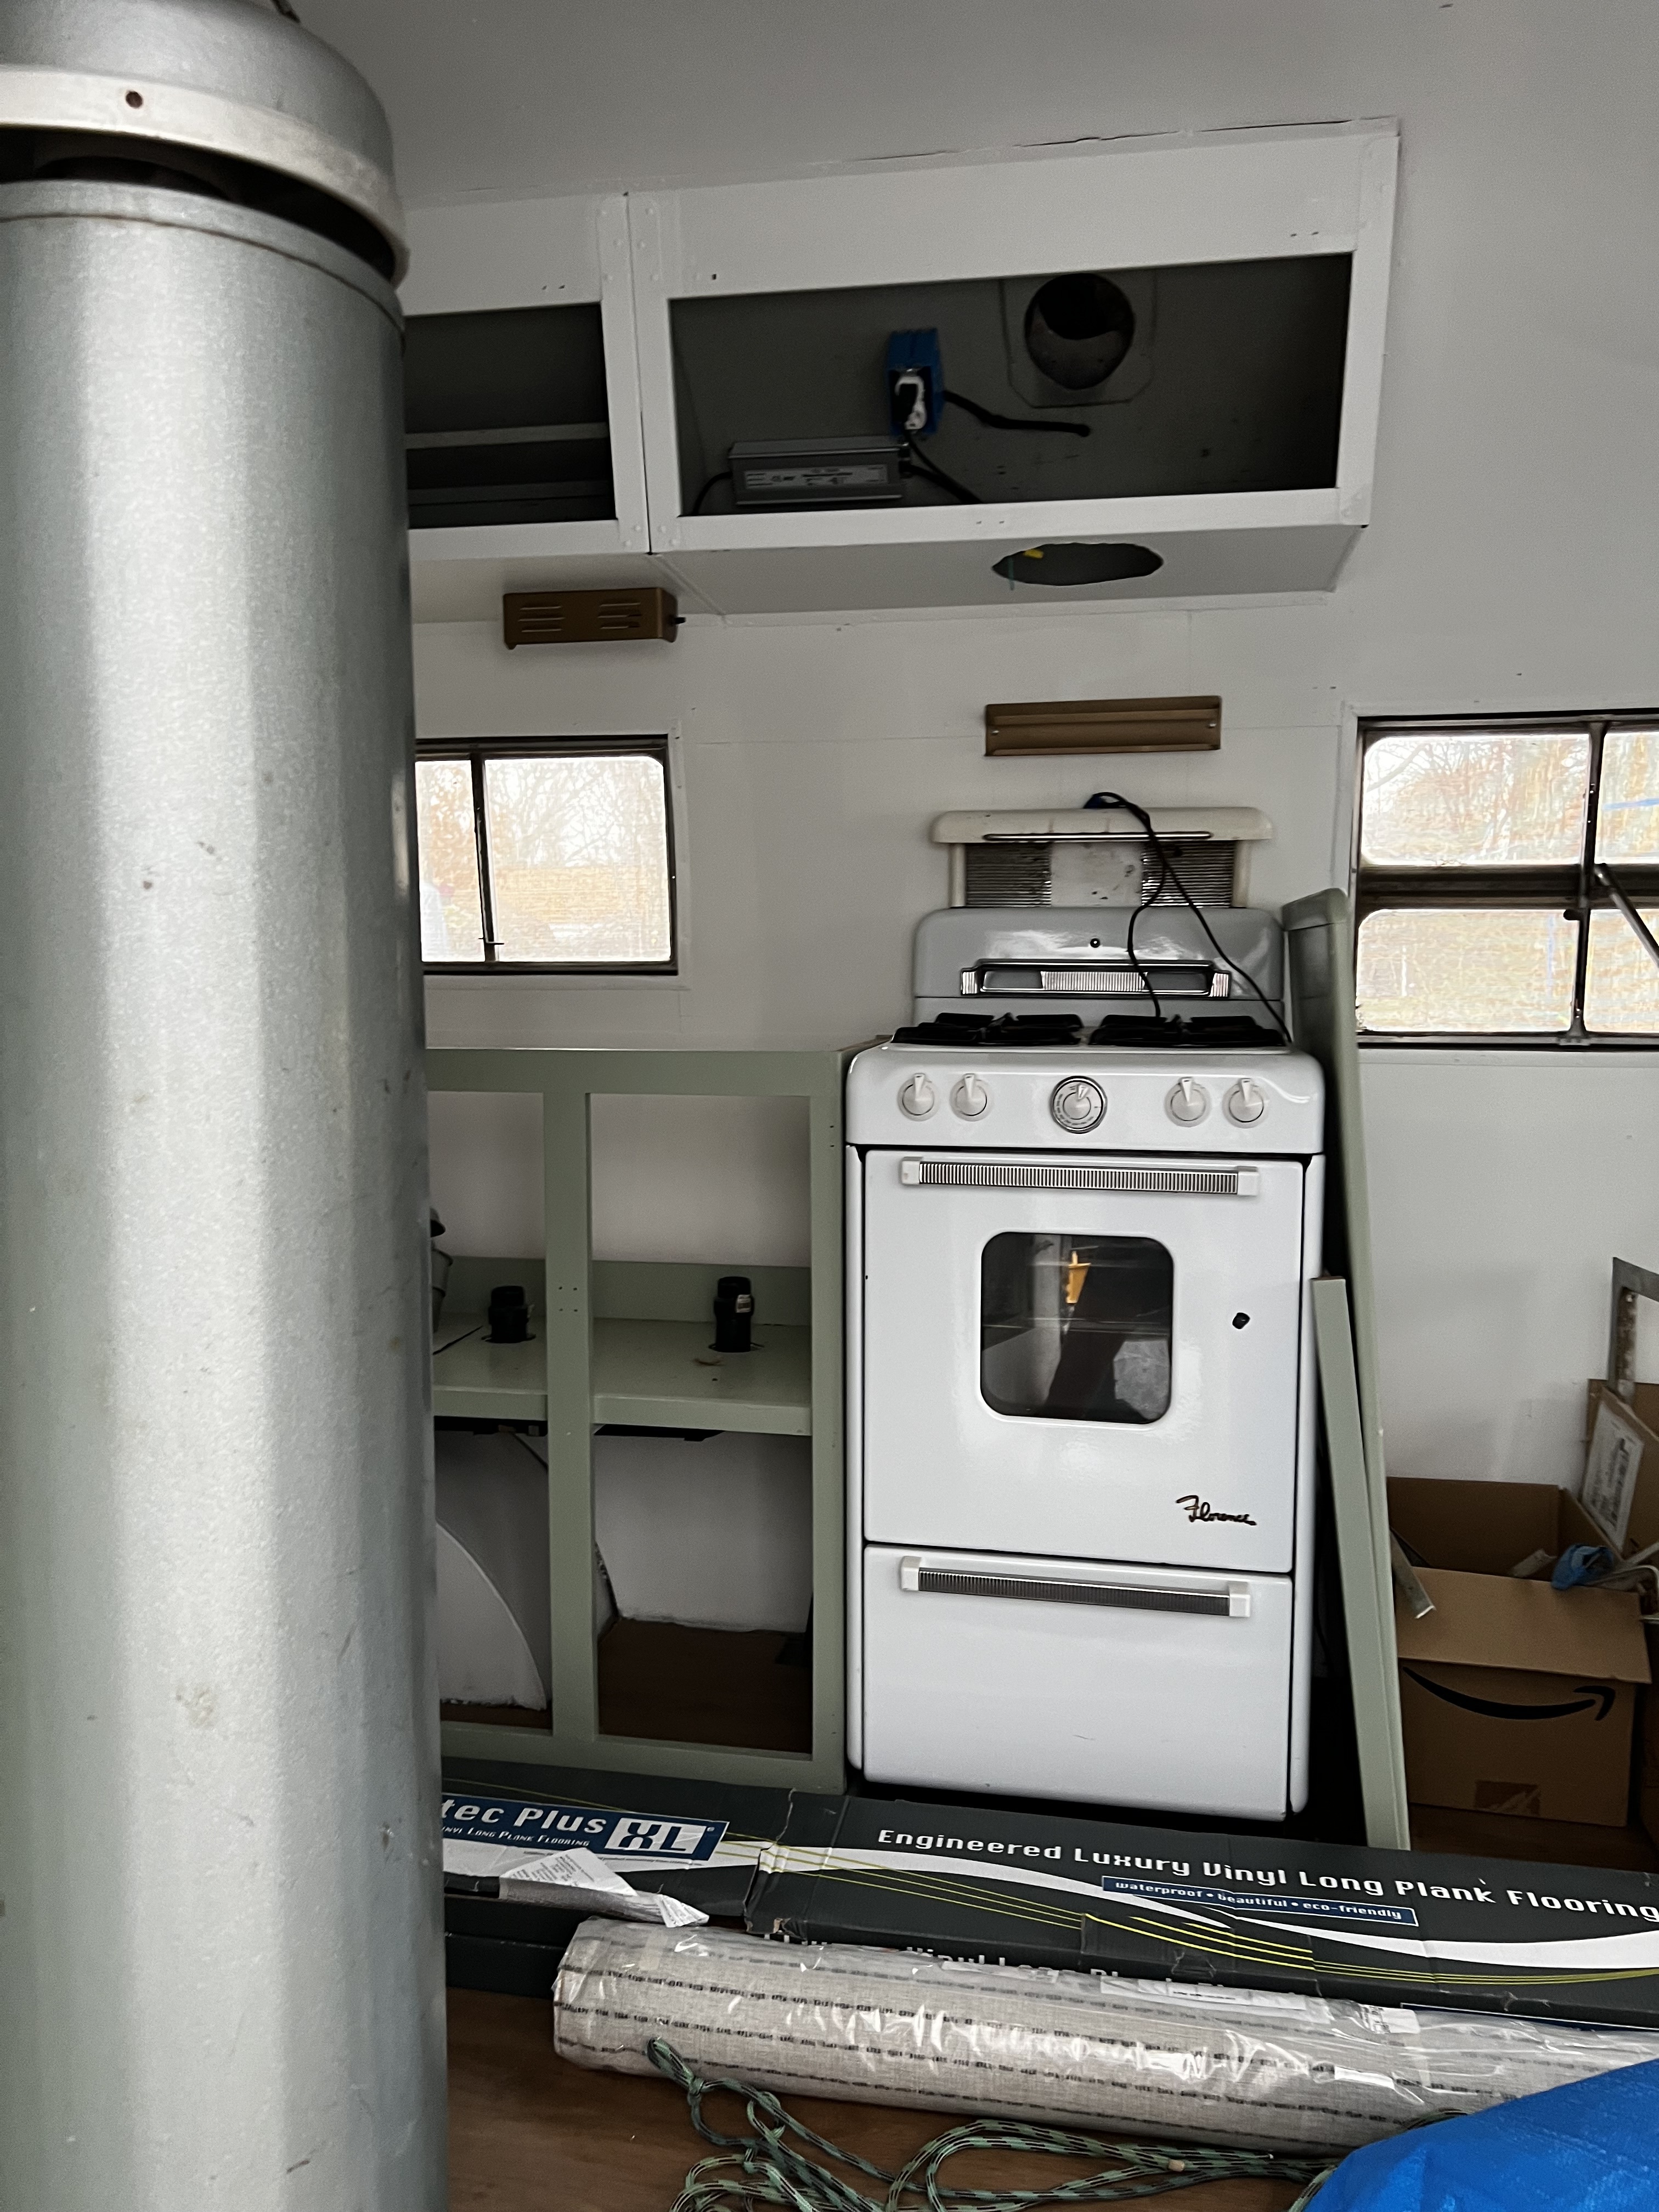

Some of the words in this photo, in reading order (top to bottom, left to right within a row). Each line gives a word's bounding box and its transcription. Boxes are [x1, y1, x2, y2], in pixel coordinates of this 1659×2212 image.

[441, 1799, 504, 1823] tec
[513, 1808, 606, 1833] Plus
[618, 1822, 686, 1851] XL
[878, 1829, 1062, 1859] Engineered
[1074, 1848, 1190, 1876] Luxury
[1203, 1862, 1287, 1886] Vinyl
[1299, 1871, 1384, 1896] Long
[1394, 1880, 1496, 1903] Plank
[1506, 1890, 1659, 1922] Flooring
[1115, 1882, 1203, 1897] waterproof
[1217, 1893, 1288, 1907] beautiful
[1302, 1901, 1402, 1920] eco-friendly
